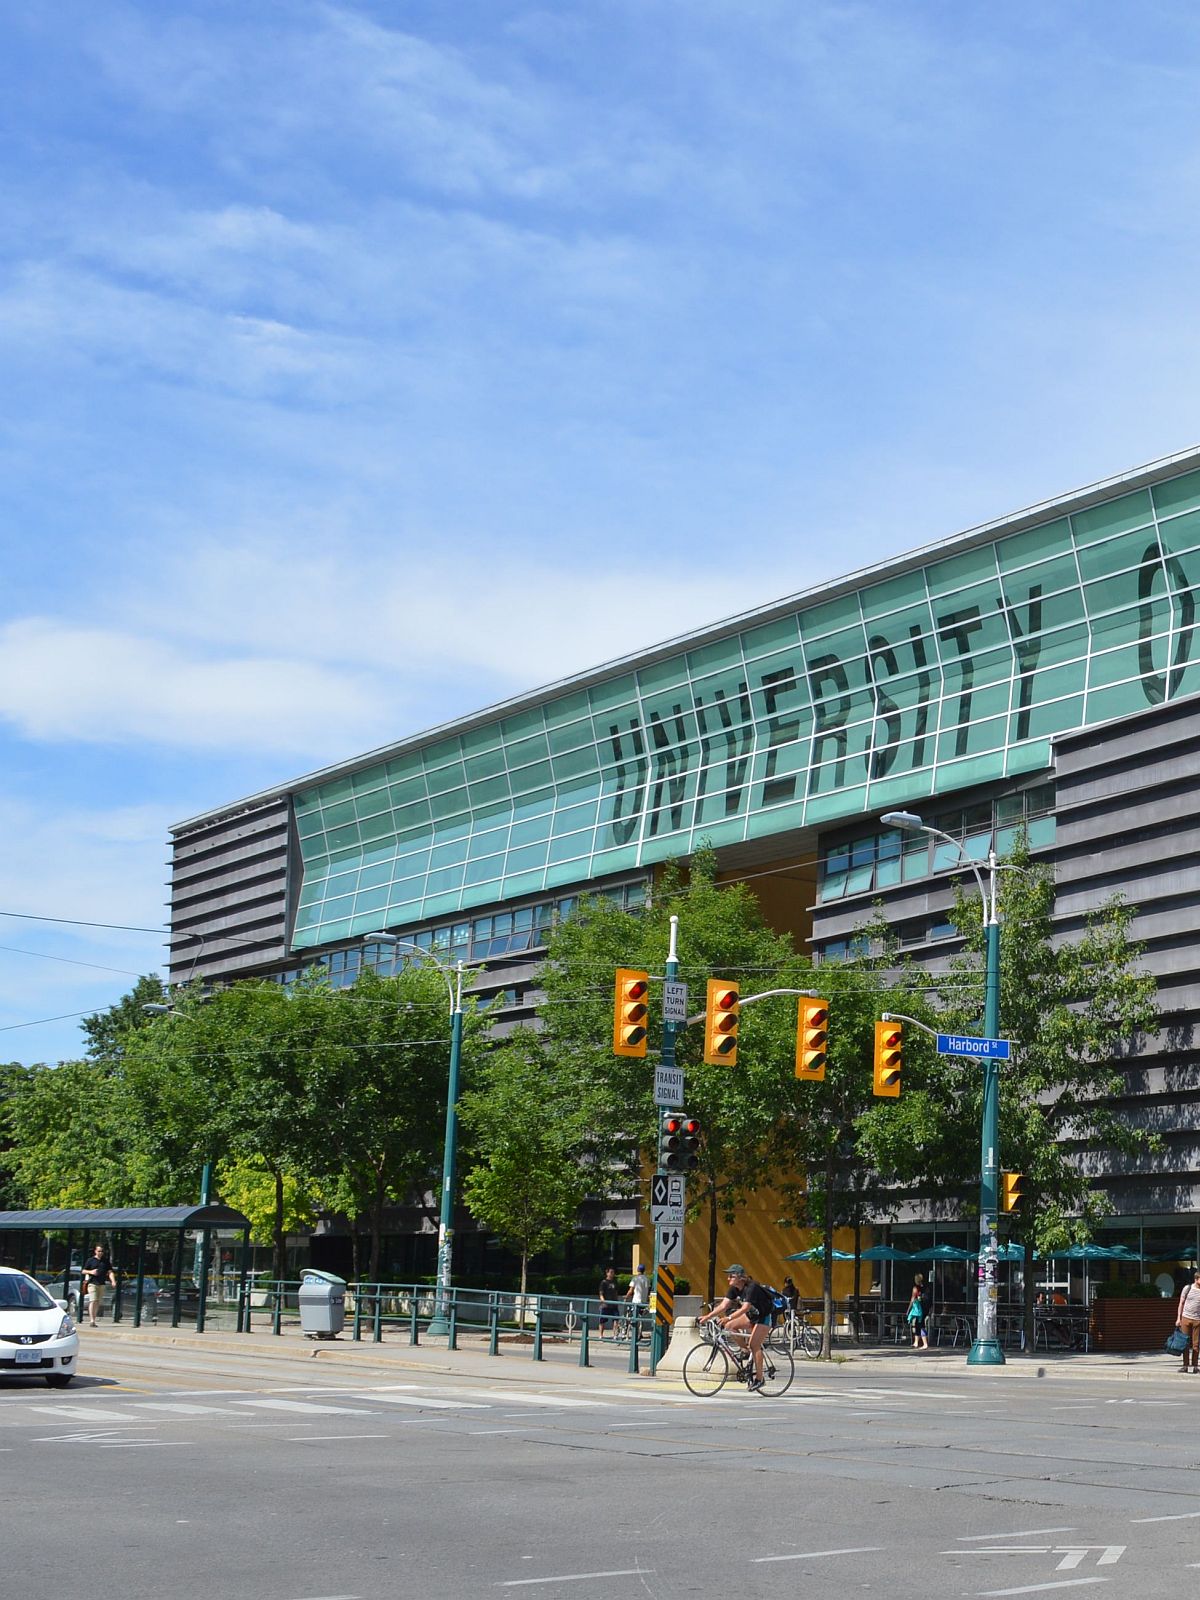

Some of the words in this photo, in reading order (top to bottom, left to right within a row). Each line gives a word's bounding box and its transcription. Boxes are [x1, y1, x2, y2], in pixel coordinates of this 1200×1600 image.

[608, 584, 1043, 846] UNIVERSITY
[667, 987, 684, 995] LEFT
[666, 997, 684, 1005] TURN
[665, 1007, 685, 1016] SIGNAL
[948, 1037, 990, 1053] Harbord
[656, 1071, 682, 1085] TRANSIT
[657, 1086, 680, 1100] SIGNAL
